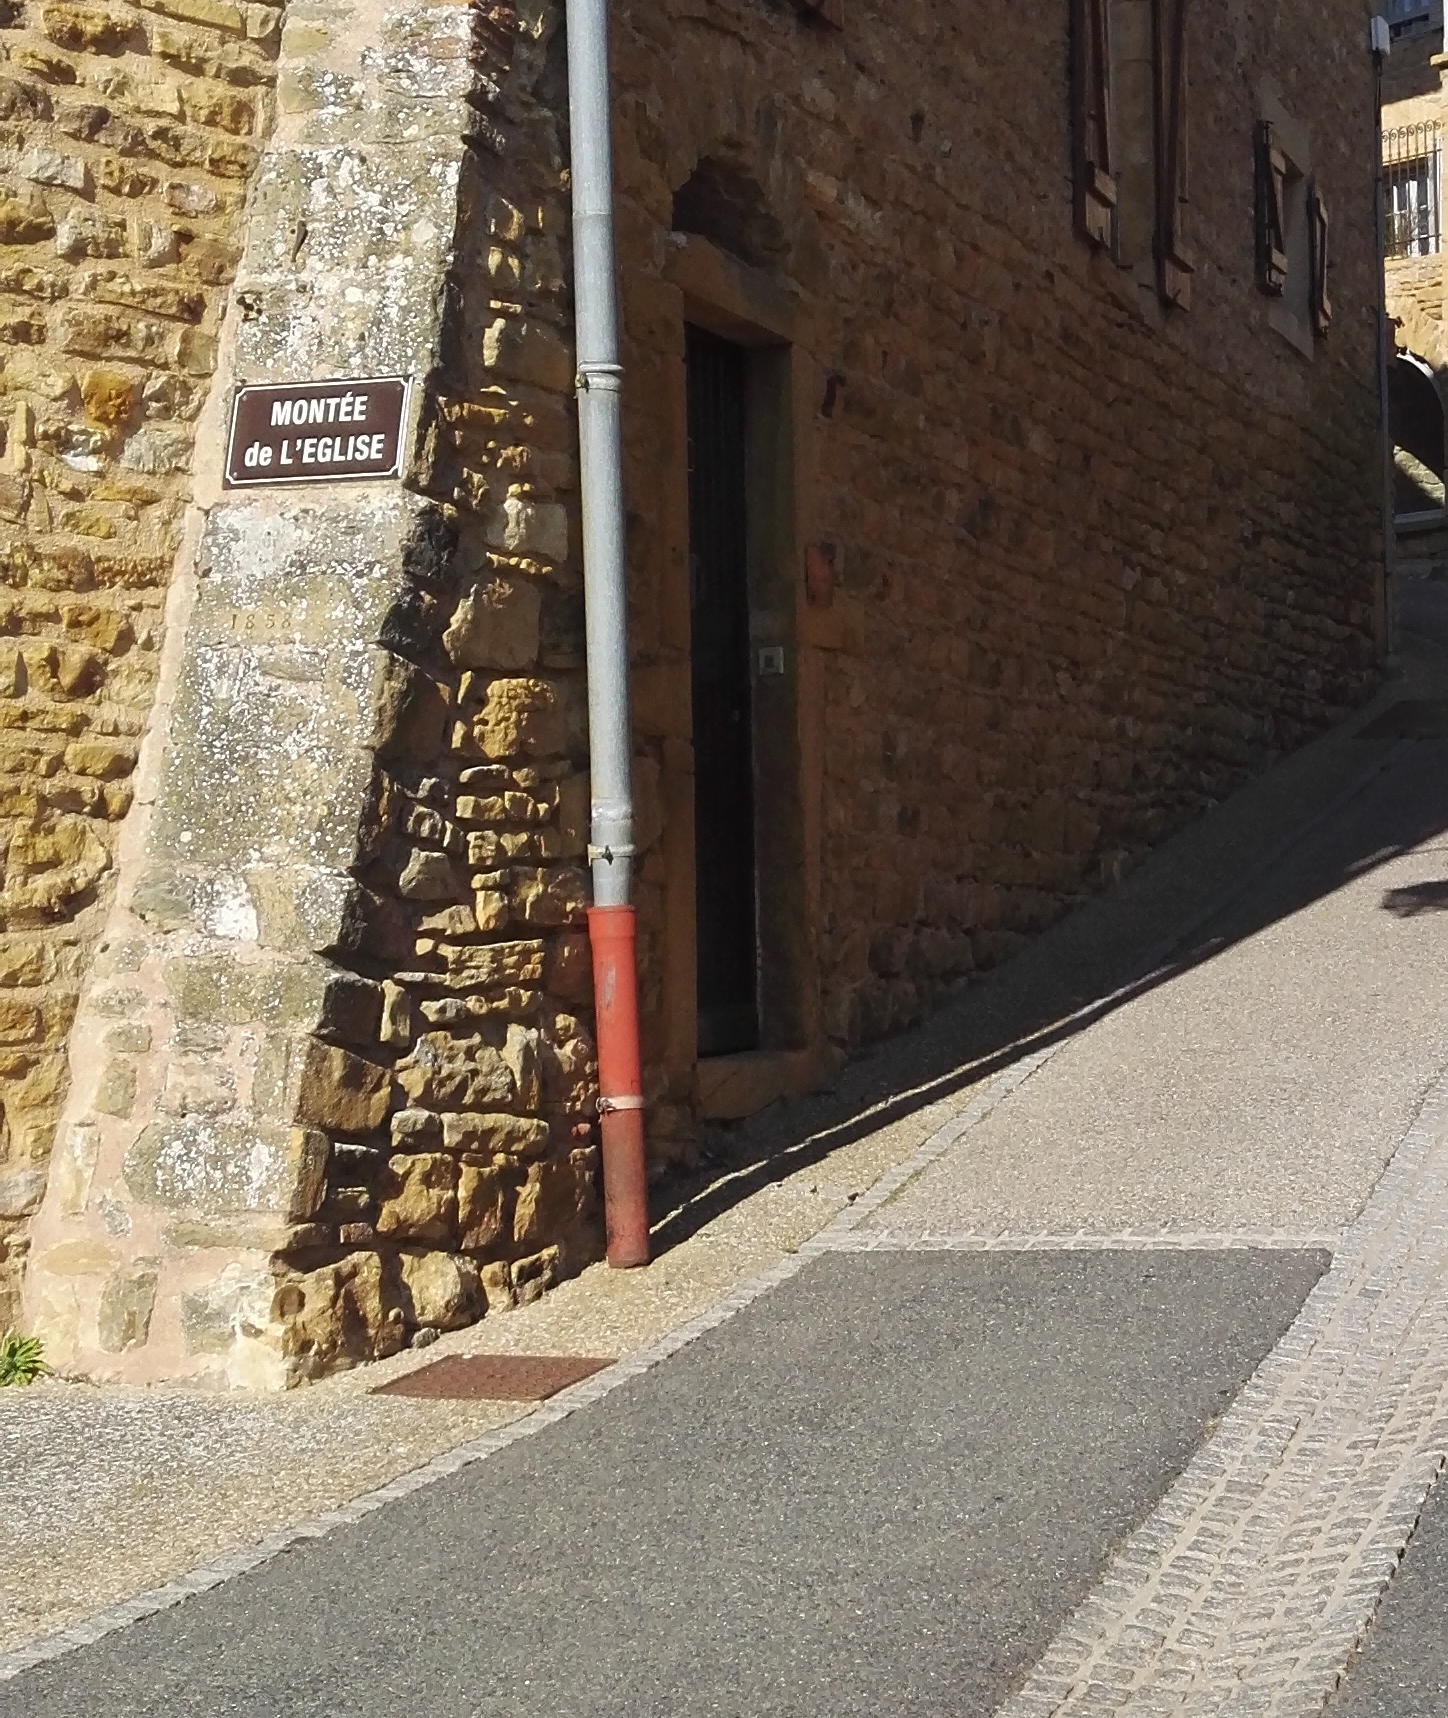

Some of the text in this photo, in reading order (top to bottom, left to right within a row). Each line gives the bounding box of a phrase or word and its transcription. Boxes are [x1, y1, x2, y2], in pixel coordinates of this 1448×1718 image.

[270, 392, 369, 427] MONTÉE
[244, 433, 386, 468] de L'EGLISE
[231, 612, 292, 630] 1858
